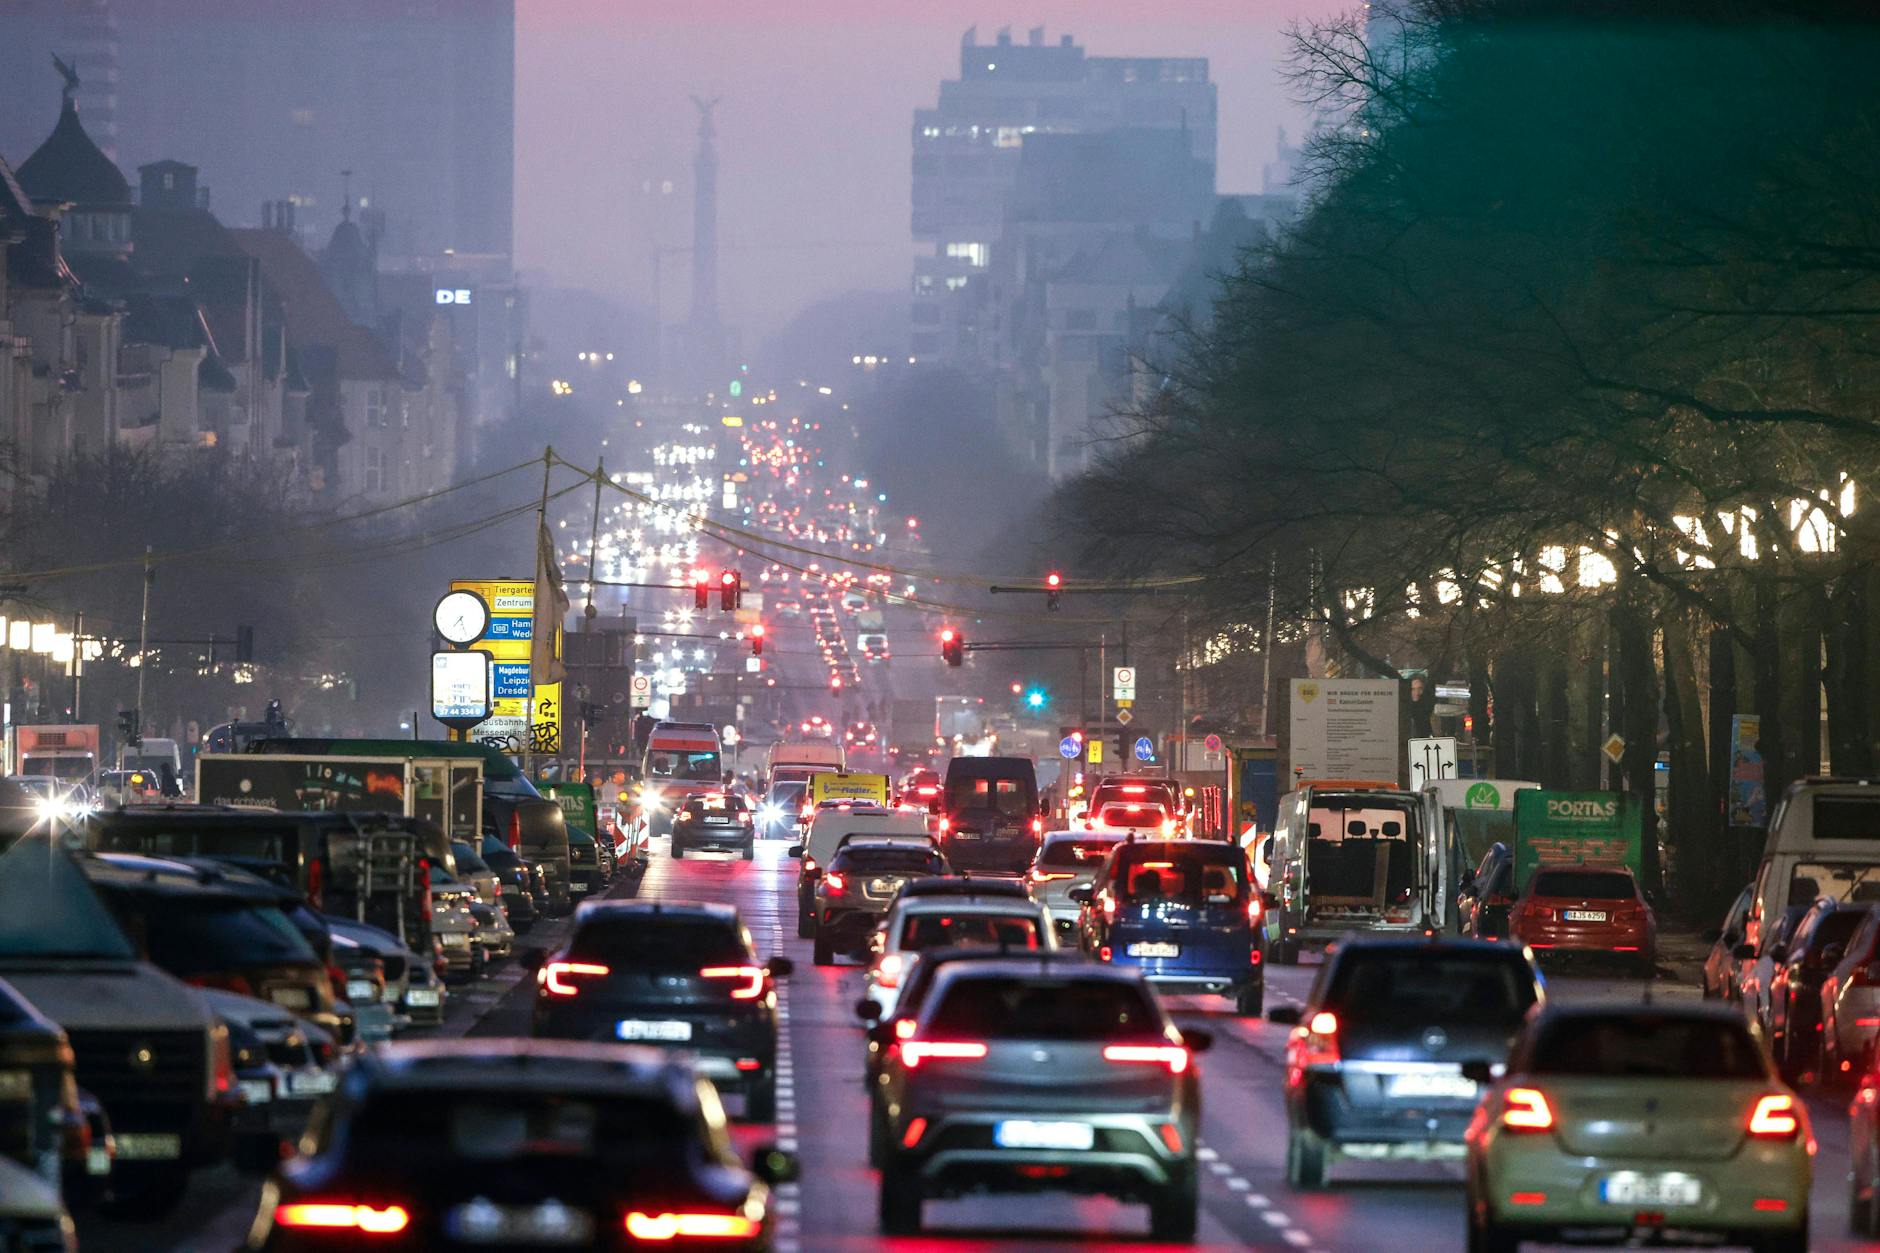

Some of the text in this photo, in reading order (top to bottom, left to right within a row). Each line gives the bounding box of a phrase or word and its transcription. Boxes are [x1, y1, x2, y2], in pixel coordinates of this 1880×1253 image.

[436, 289, 471, 304] DE
[496, 598, 532, 607] Zentrum
[498, 666, 530, 676] Magdebur
[483, 718, 528, 726] Busbahnho
[558, 796, 584, 811] RTAS
[1547, 800, 1616, 816] PORTAS
